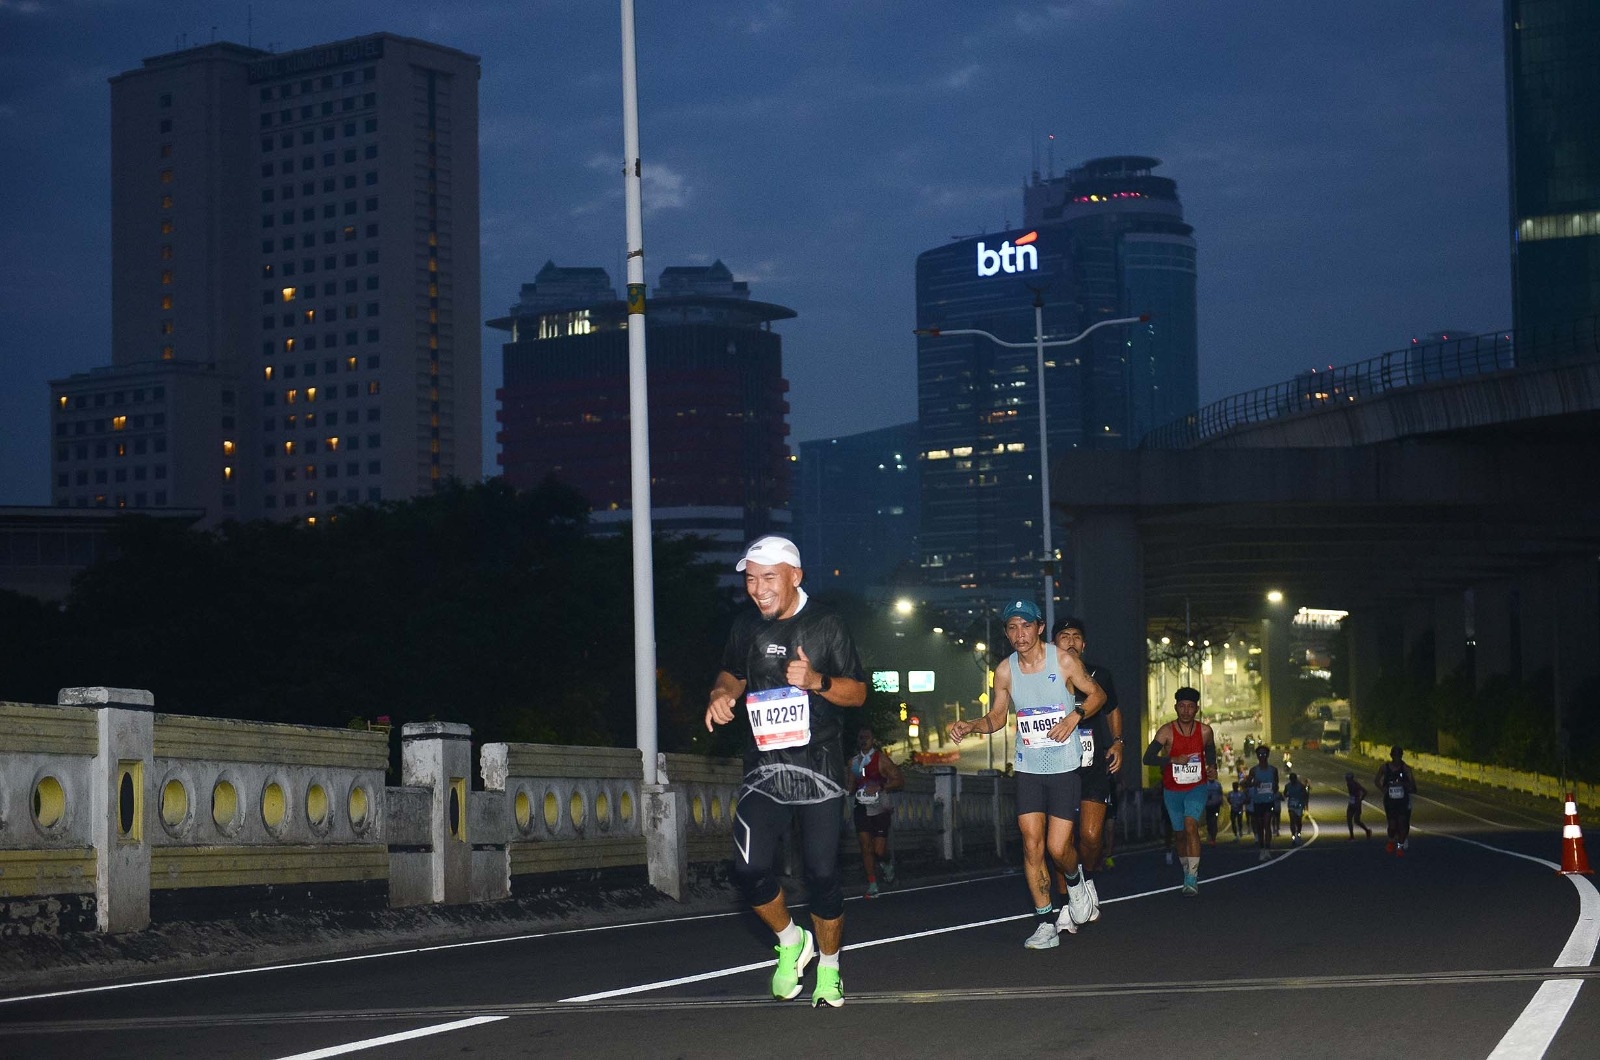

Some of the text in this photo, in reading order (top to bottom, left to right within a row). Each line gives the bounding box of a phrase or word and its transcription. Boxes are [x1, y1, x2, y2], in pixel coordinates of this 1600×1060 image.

[977, 240, 1038, 277] btn
[750, 703, 804, 728] M 42297
[1020, 720, 1031, 734] M
